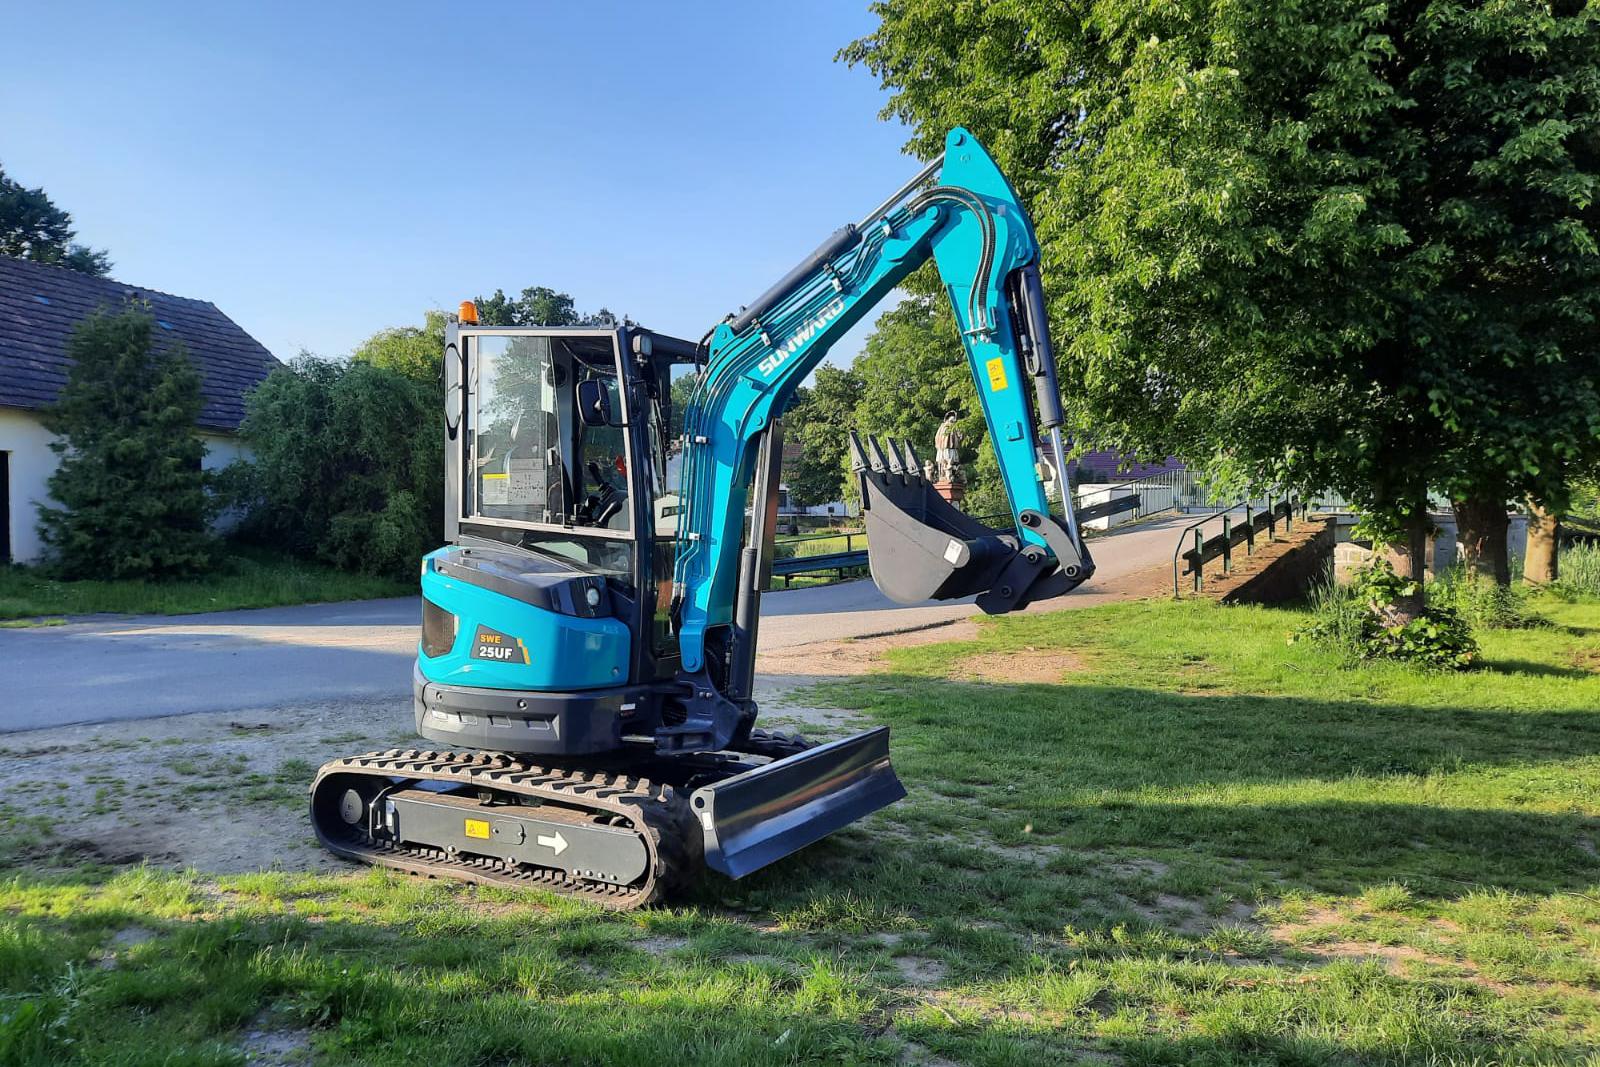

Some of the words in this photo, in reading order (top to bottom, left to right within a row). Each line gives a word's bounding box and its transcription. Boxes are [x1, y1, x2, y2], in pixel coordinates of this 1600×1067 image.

[757, 294, 845, 378] SUNWARD
[480, 634, 502, 643] SWE
[479, 646, 513, 659] 25UF
